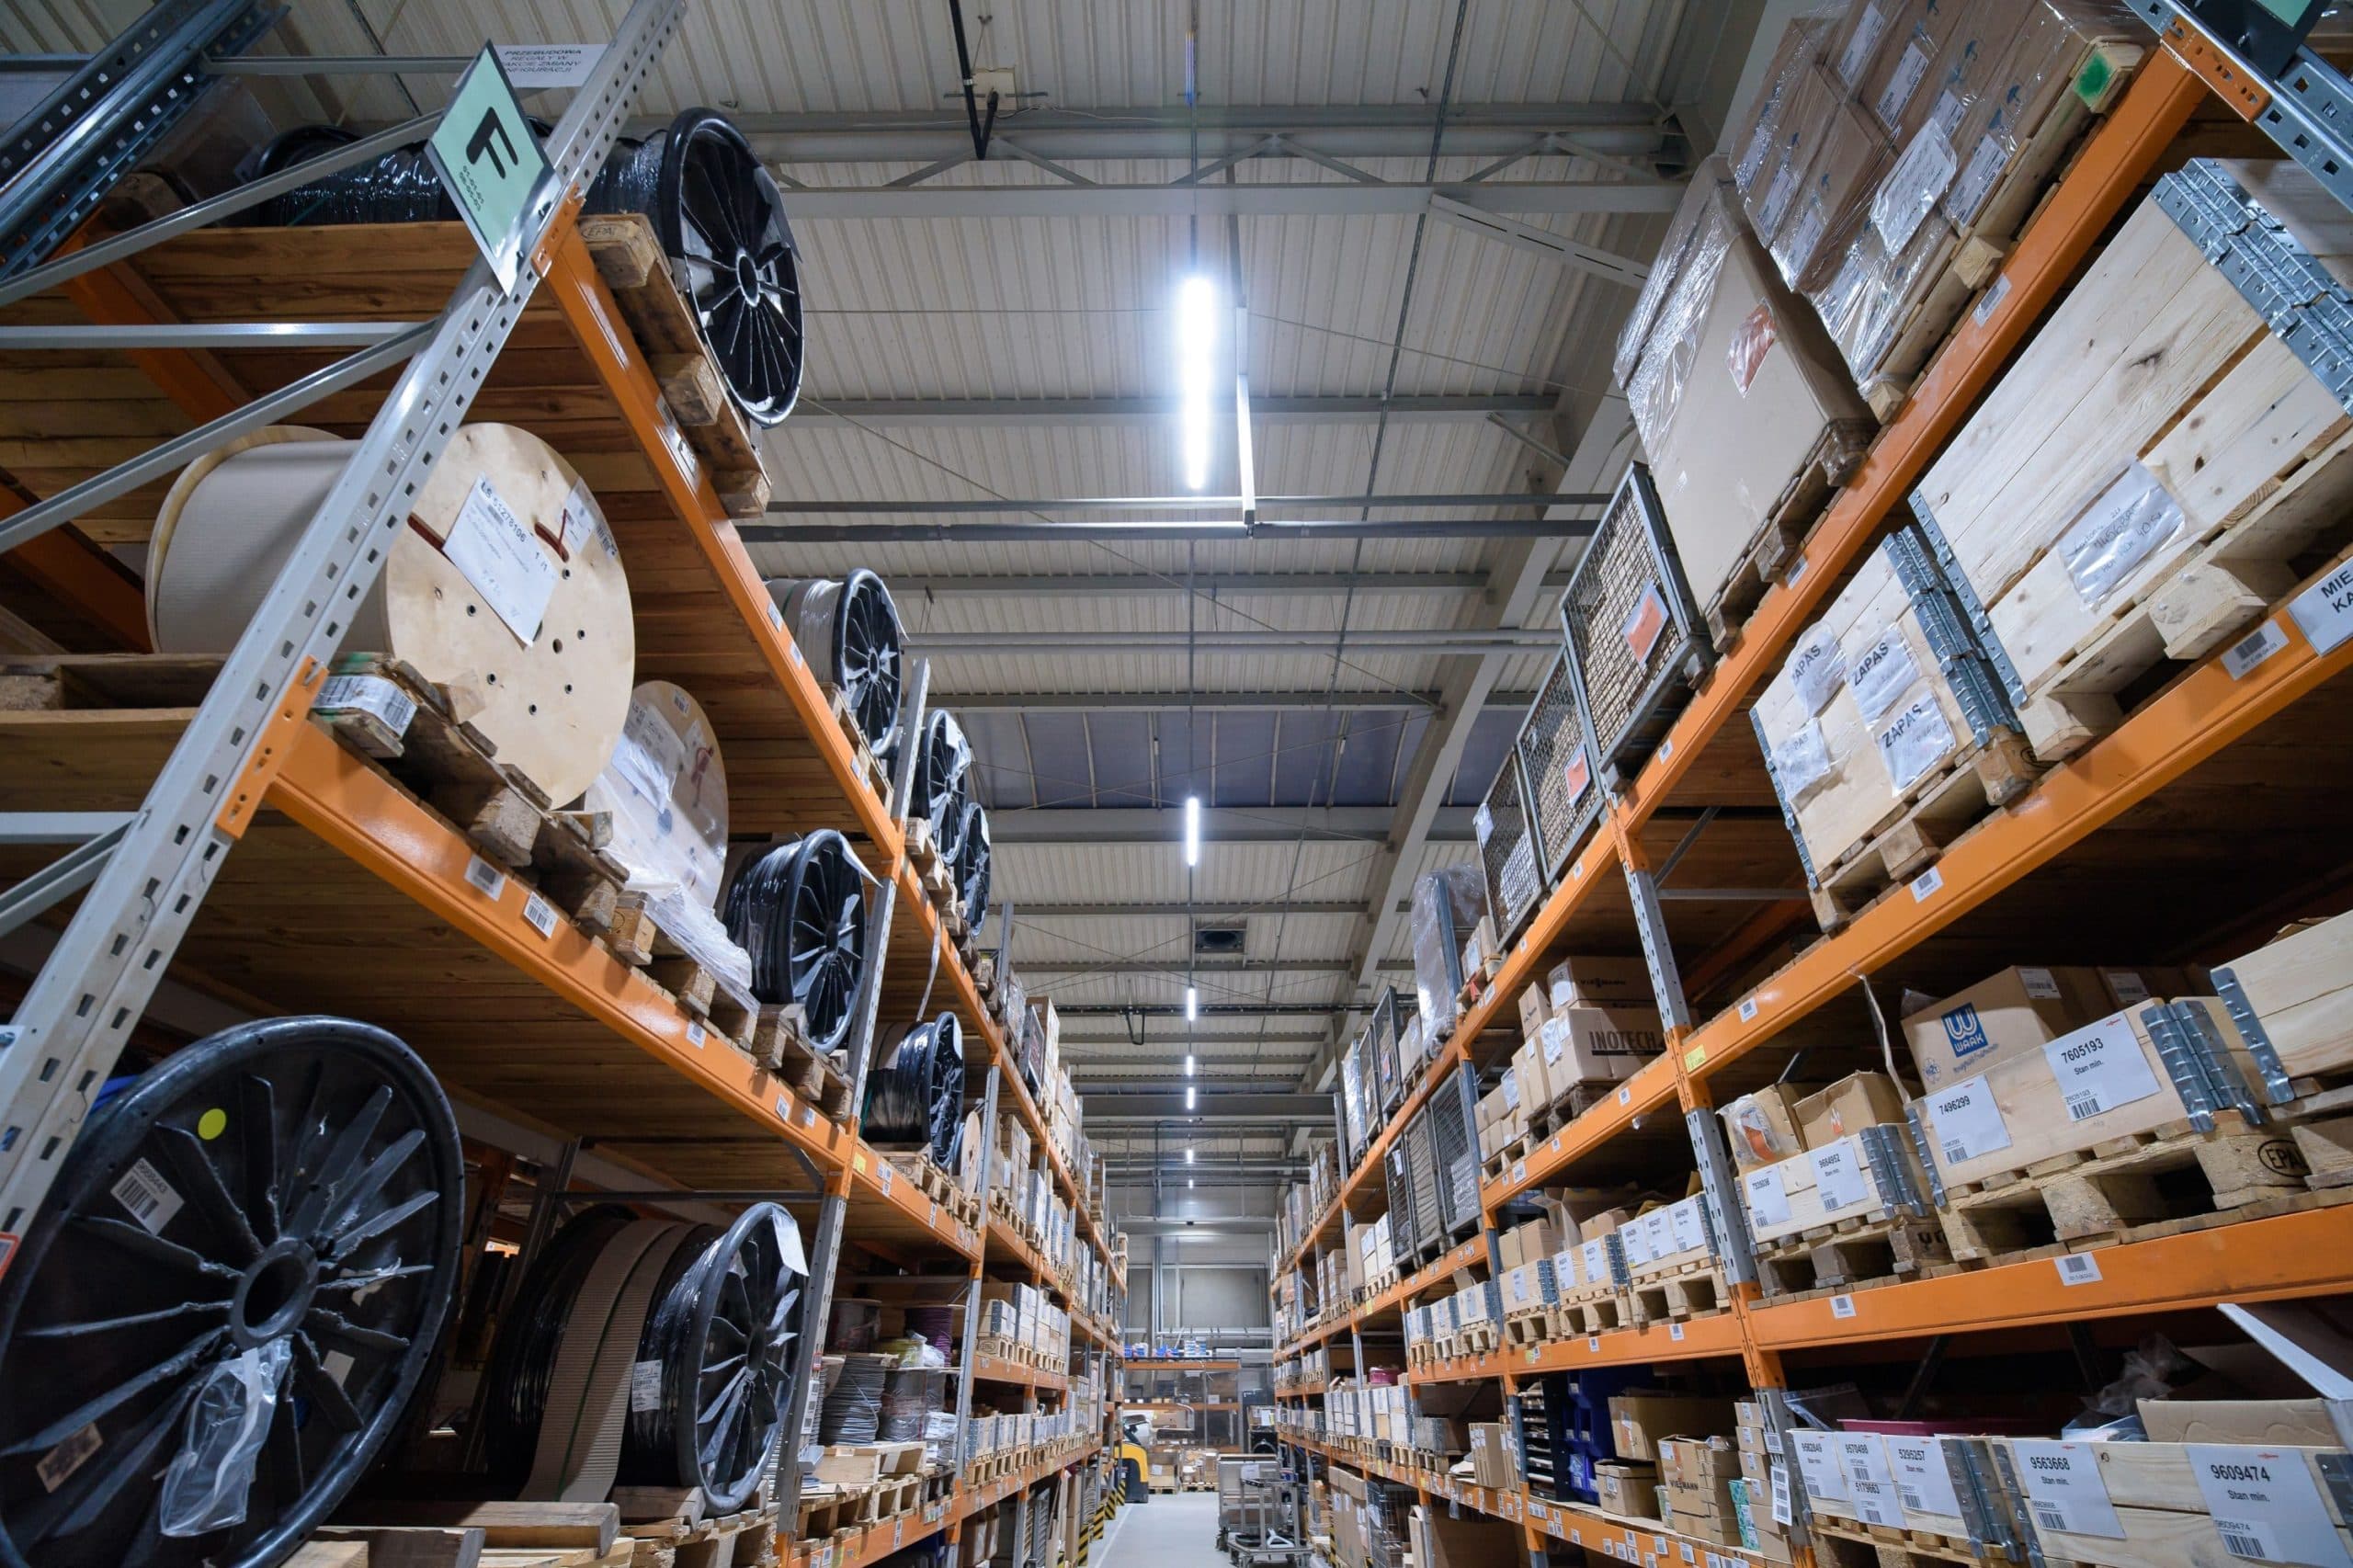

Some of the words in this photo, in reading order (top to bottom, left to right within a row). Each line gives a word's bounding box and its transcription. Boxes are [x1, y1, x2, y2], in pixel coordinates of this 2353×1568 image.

[466, 107, 518, 179] F
[2321, 570, 2353, 597] MIE
[1851, 642, 1890, 687] ZAPAS
[1881, 703, 1923, 749] ZAPAS
[1589, 1030, 1656, 1051] INOTECH
[1953, 1032, 1985, 1053] WAAK
[2061, 1038, 2104, 1064] 7605193
[2074, 1064, 2089, 1075] Stan
[2088, 1059, 2104, 1070] min.
[1938, 1096, 1972, 1115] 7496299
[2029, 1456, 2071, 1471] 9563668
[2211, 1464, 2270, 1483] 9609474
[2040, 1476, 2054, 1484] Stan
[2227, 1490, 2248, 1501] Stan
[2249, 1492, 2271, 1503] min.
